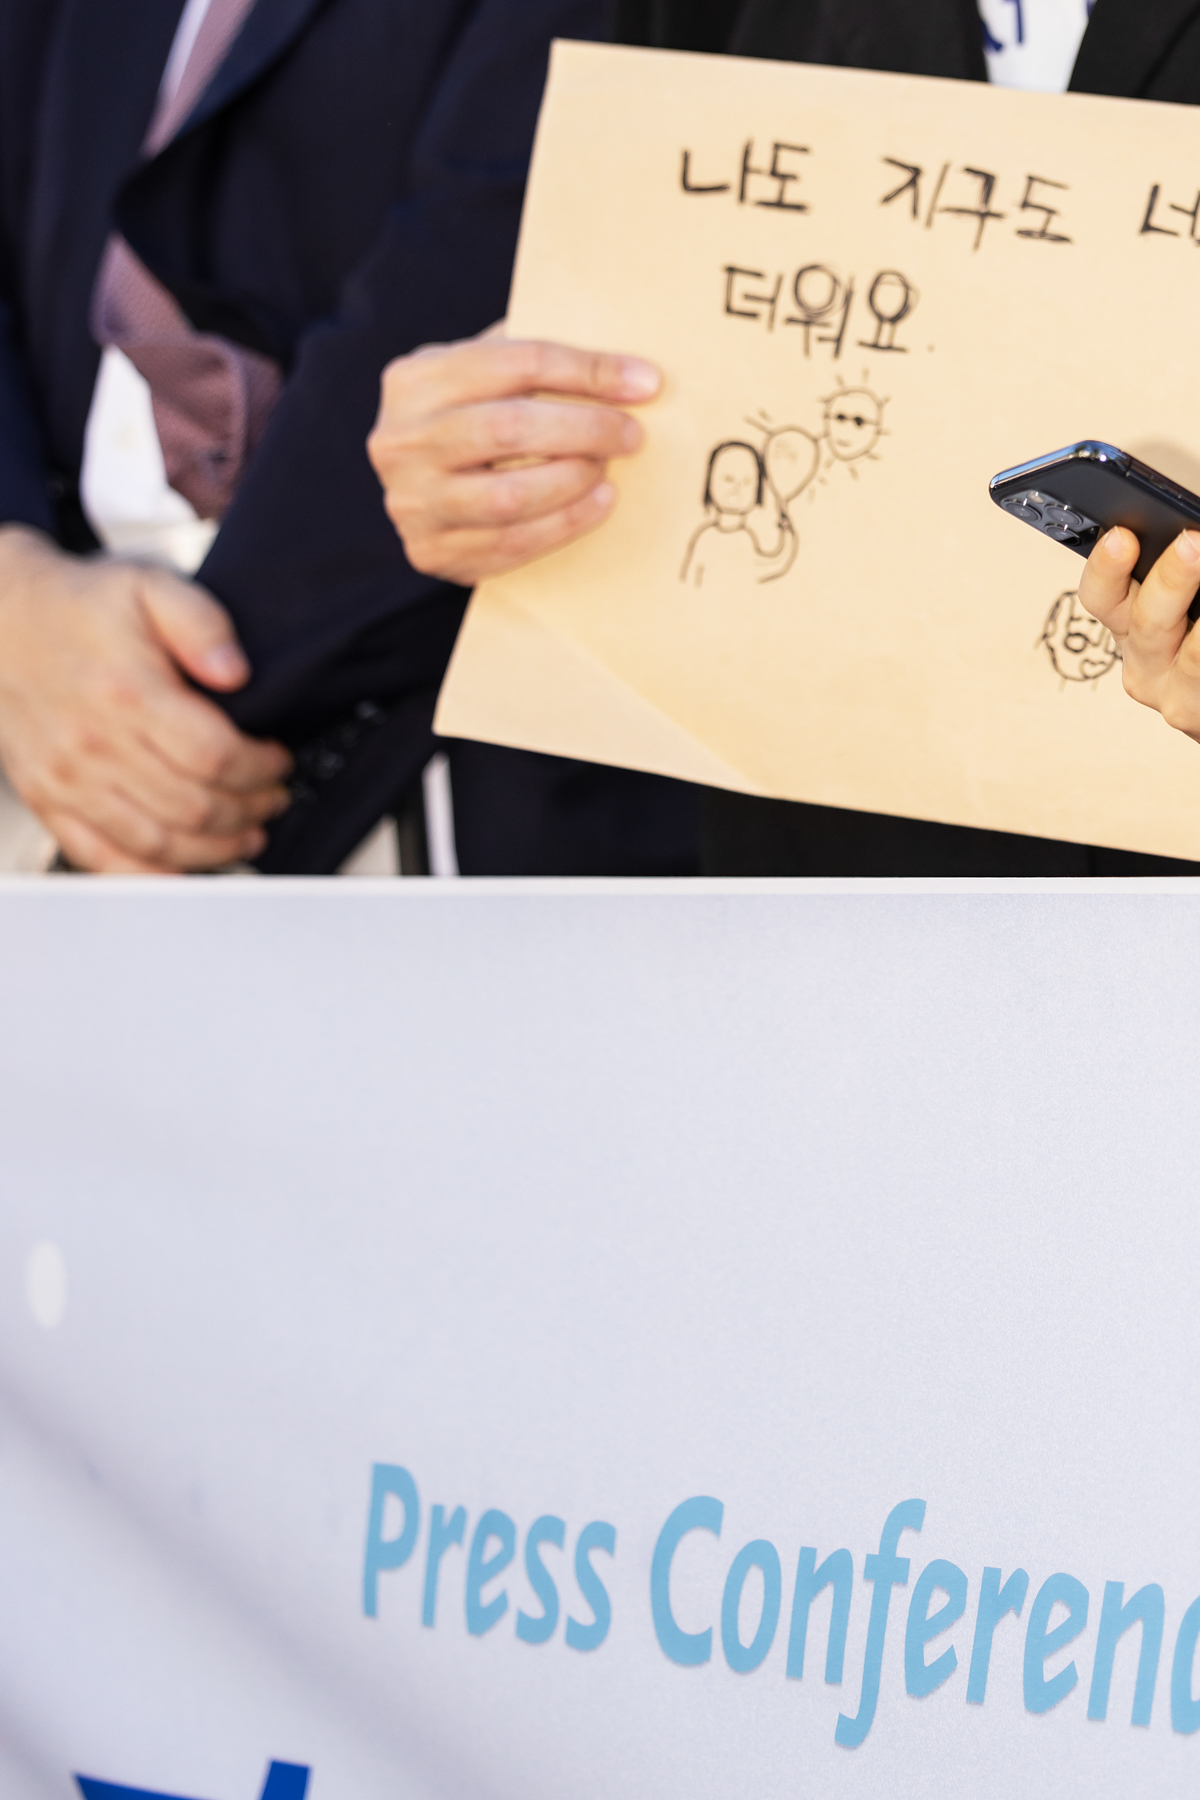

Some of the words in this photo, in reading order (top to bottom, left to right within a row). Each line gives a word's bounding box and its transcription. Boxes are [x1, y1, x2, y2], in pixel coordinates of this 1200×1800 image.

[681, 138, 812, 214] 나도
[881, 156, 1072, 251] 지구도
[363, 1463, 616, 1650] Press
